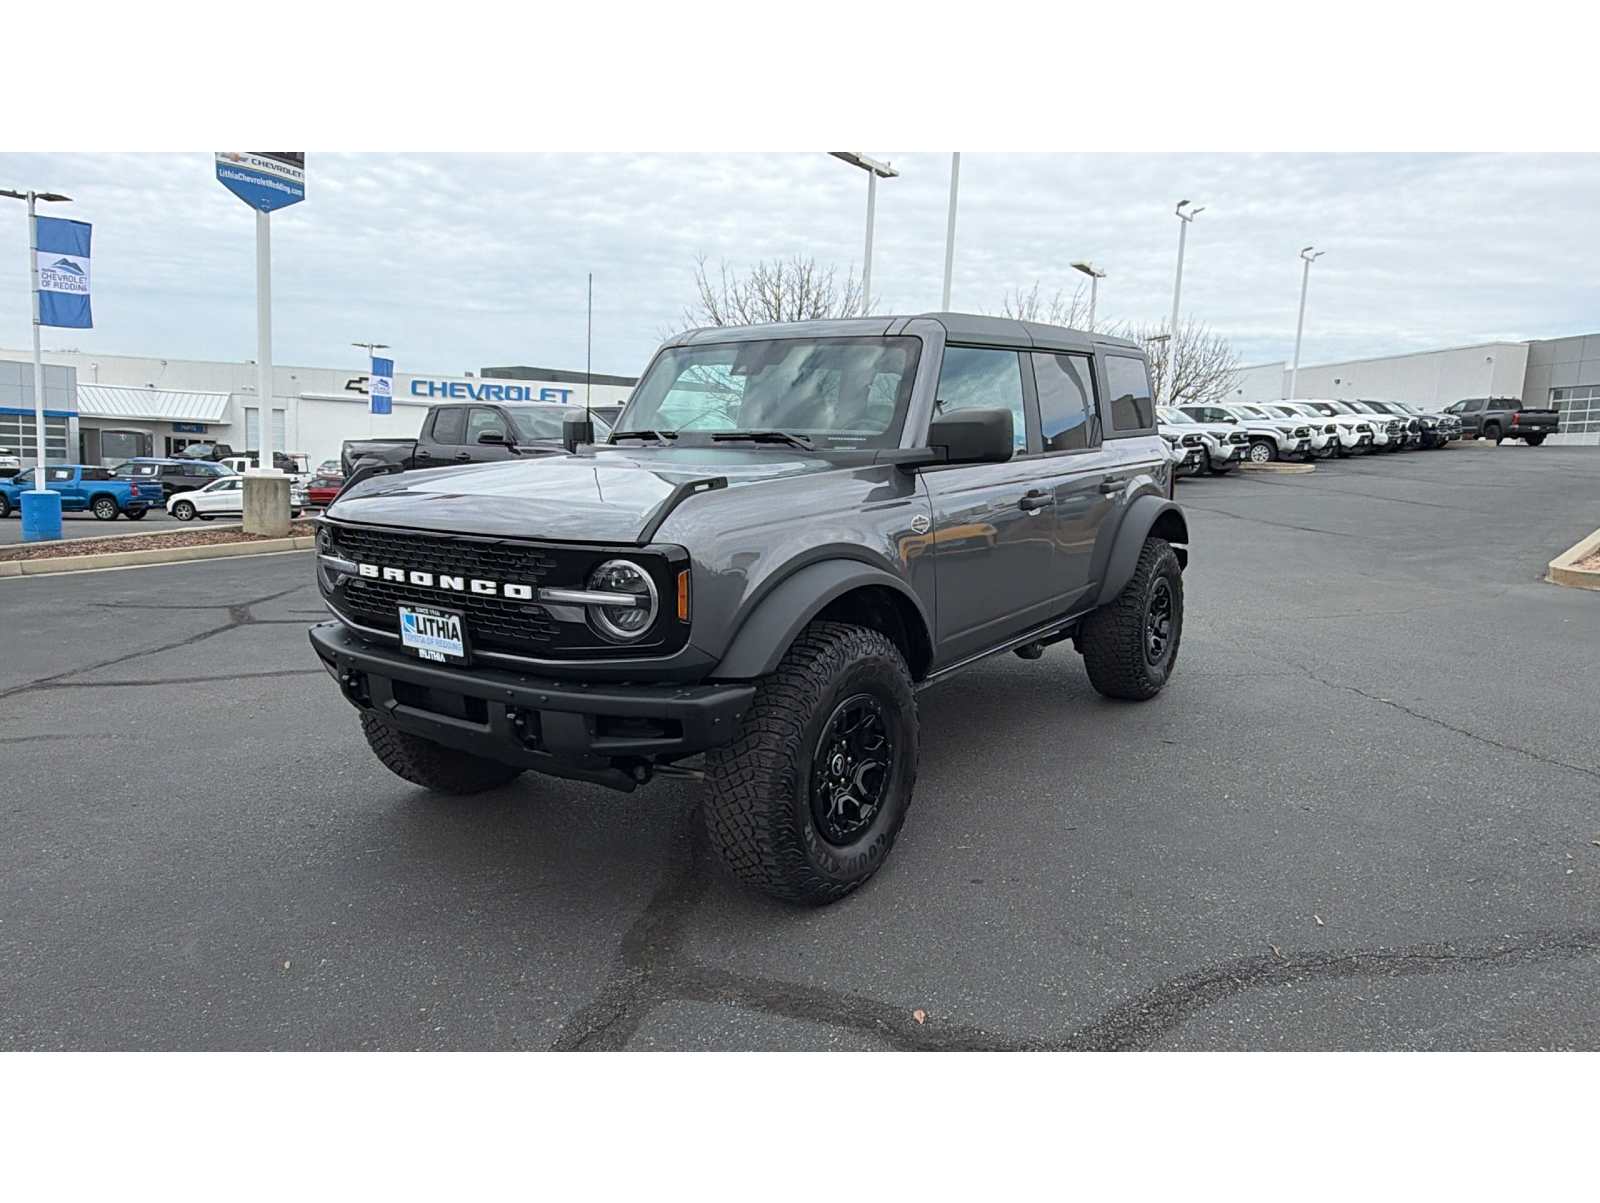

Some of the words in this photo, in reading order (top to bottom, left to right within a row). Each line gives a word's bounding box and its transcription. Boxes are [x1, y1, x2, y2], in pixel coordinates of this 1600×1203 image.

[251, 158, 303, 178] CHEVROLET
[41, 271, 87, 285] CHEVROLET
[41, 279, 51, 288] OF
[411, 379, 573, 404] CHEVROLET
[359, 563, 533, 600] BRONCO
[416, 615, 461, 642] LITHIA
